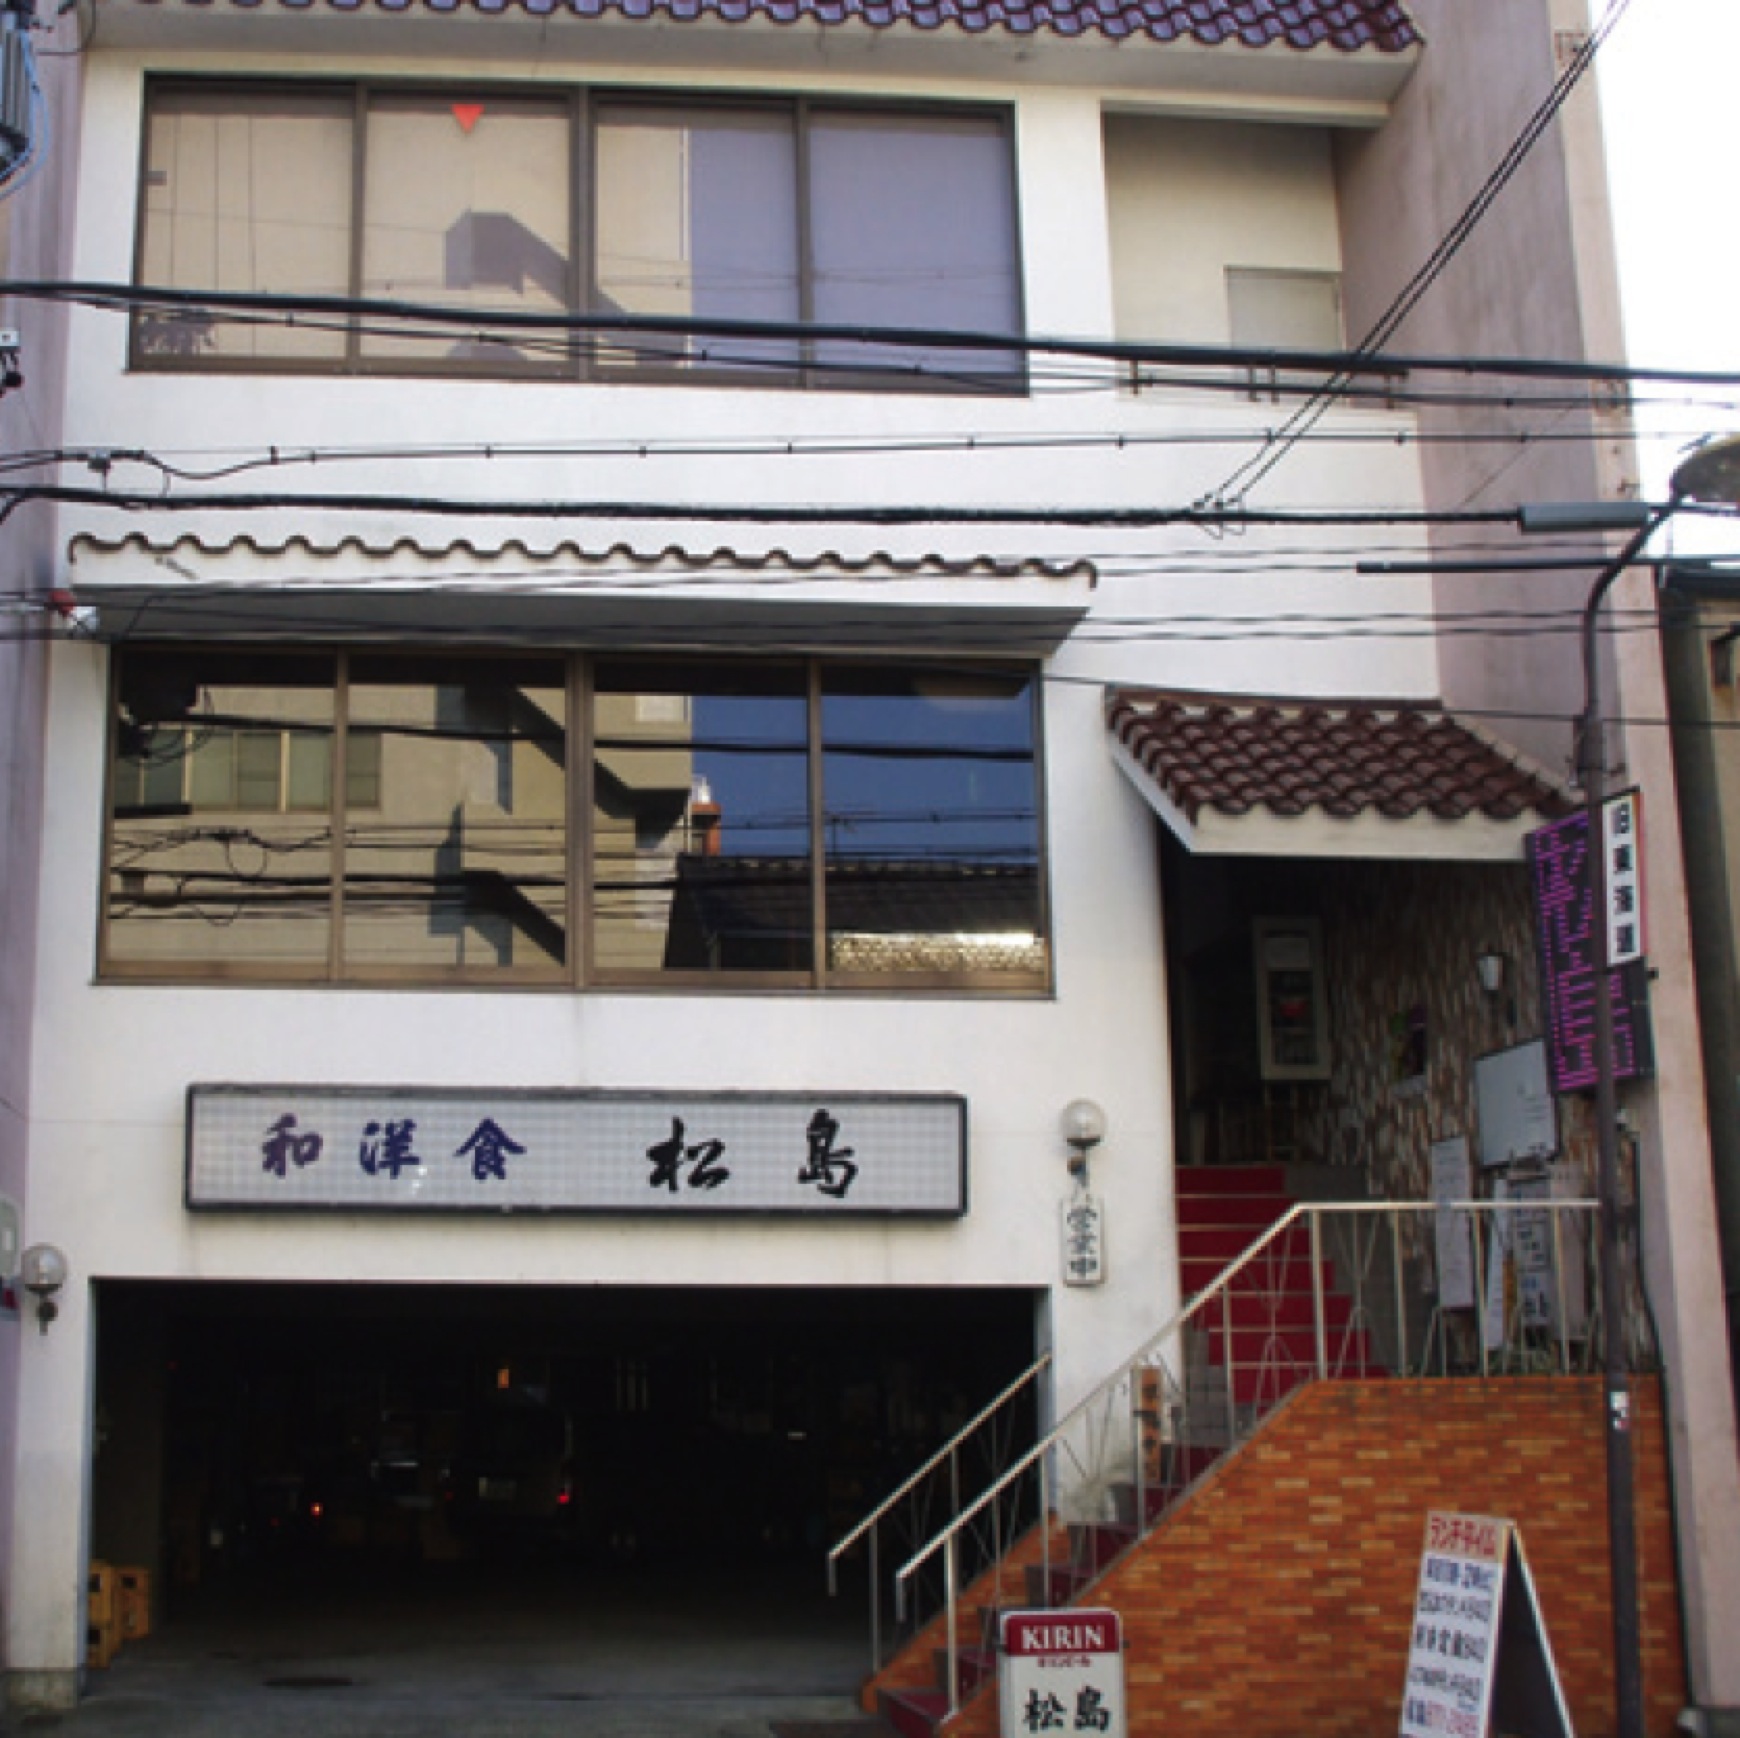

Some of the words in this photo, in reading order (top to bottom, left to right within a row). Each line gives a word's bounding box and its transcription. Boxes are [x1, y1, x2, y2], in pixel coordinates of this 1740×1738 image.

[261, 1115, 526, 1181] 和洋食
[646, 1107, 858, 1199] 松島
[1022, 1625, 1105, 1649] KIRIN
[1023, 1685, 1110, 1734] 松島
